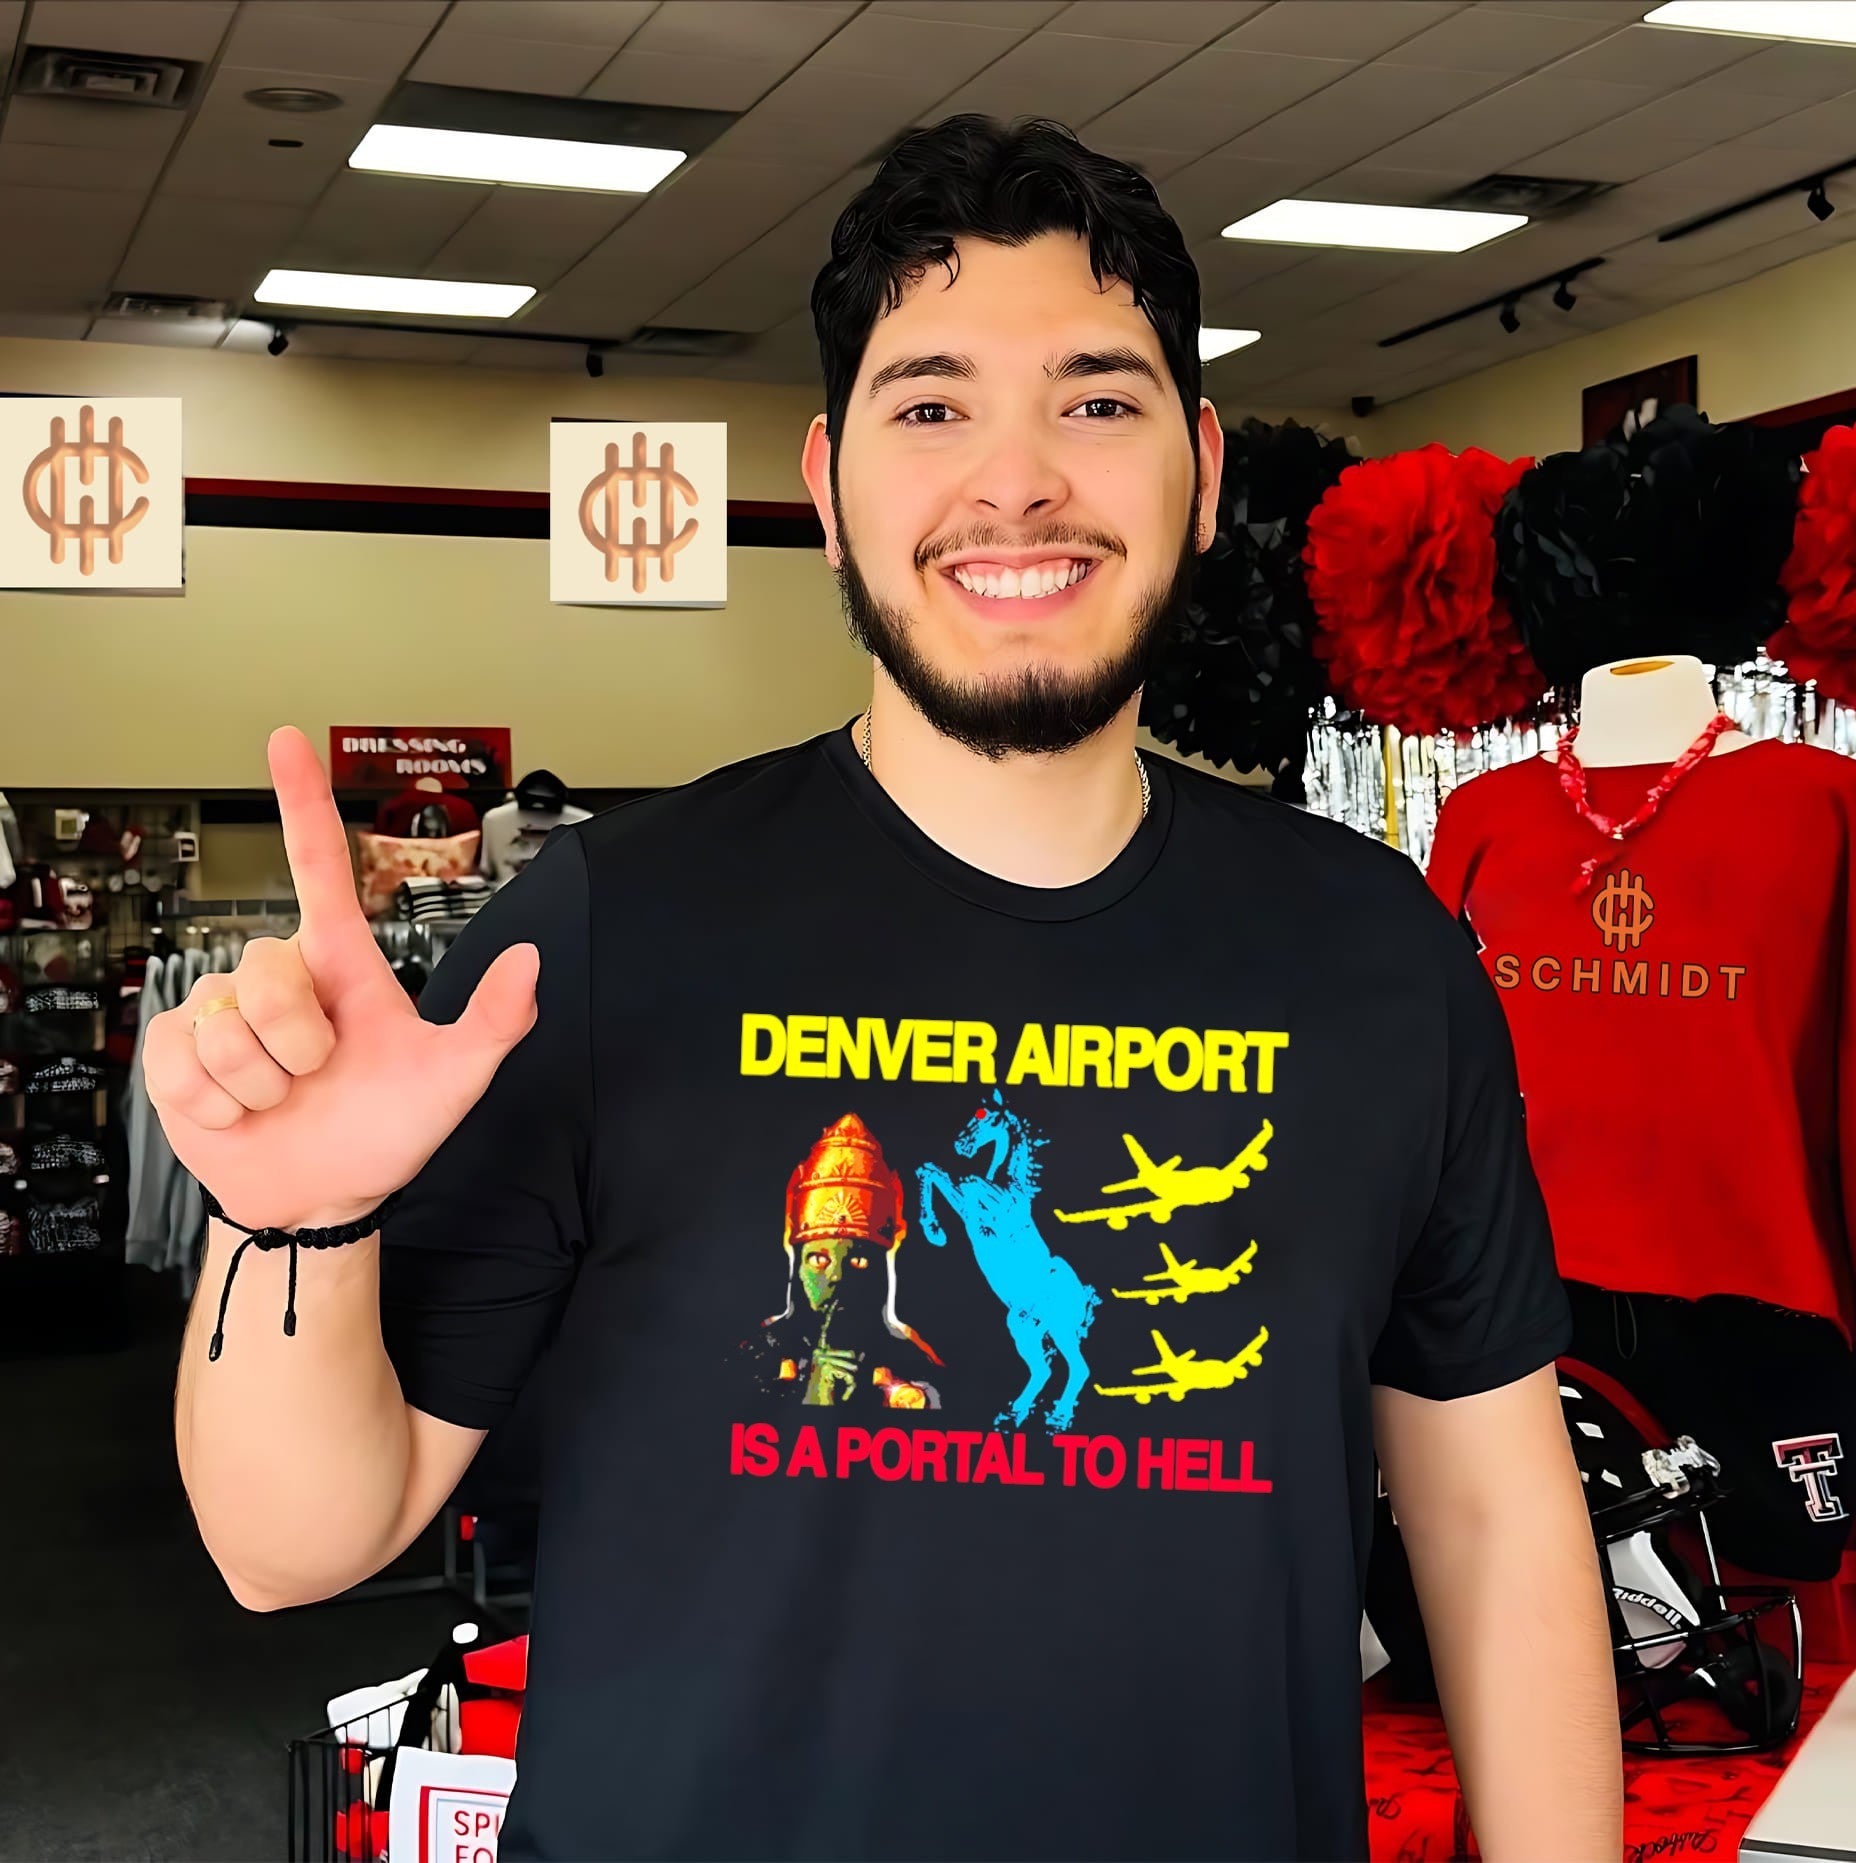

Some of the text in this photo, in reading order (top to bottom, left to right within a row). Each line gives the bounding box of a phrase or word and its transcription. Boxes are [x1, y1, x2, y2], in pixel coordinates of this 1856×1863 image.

[1494, 954, 1747, 1000] SCHMIDT
[740, 1013, 1290, 1094] DENVER AIRPORT
[730, 1422, 1273, 1494] IS A PORTAL TO HELL
